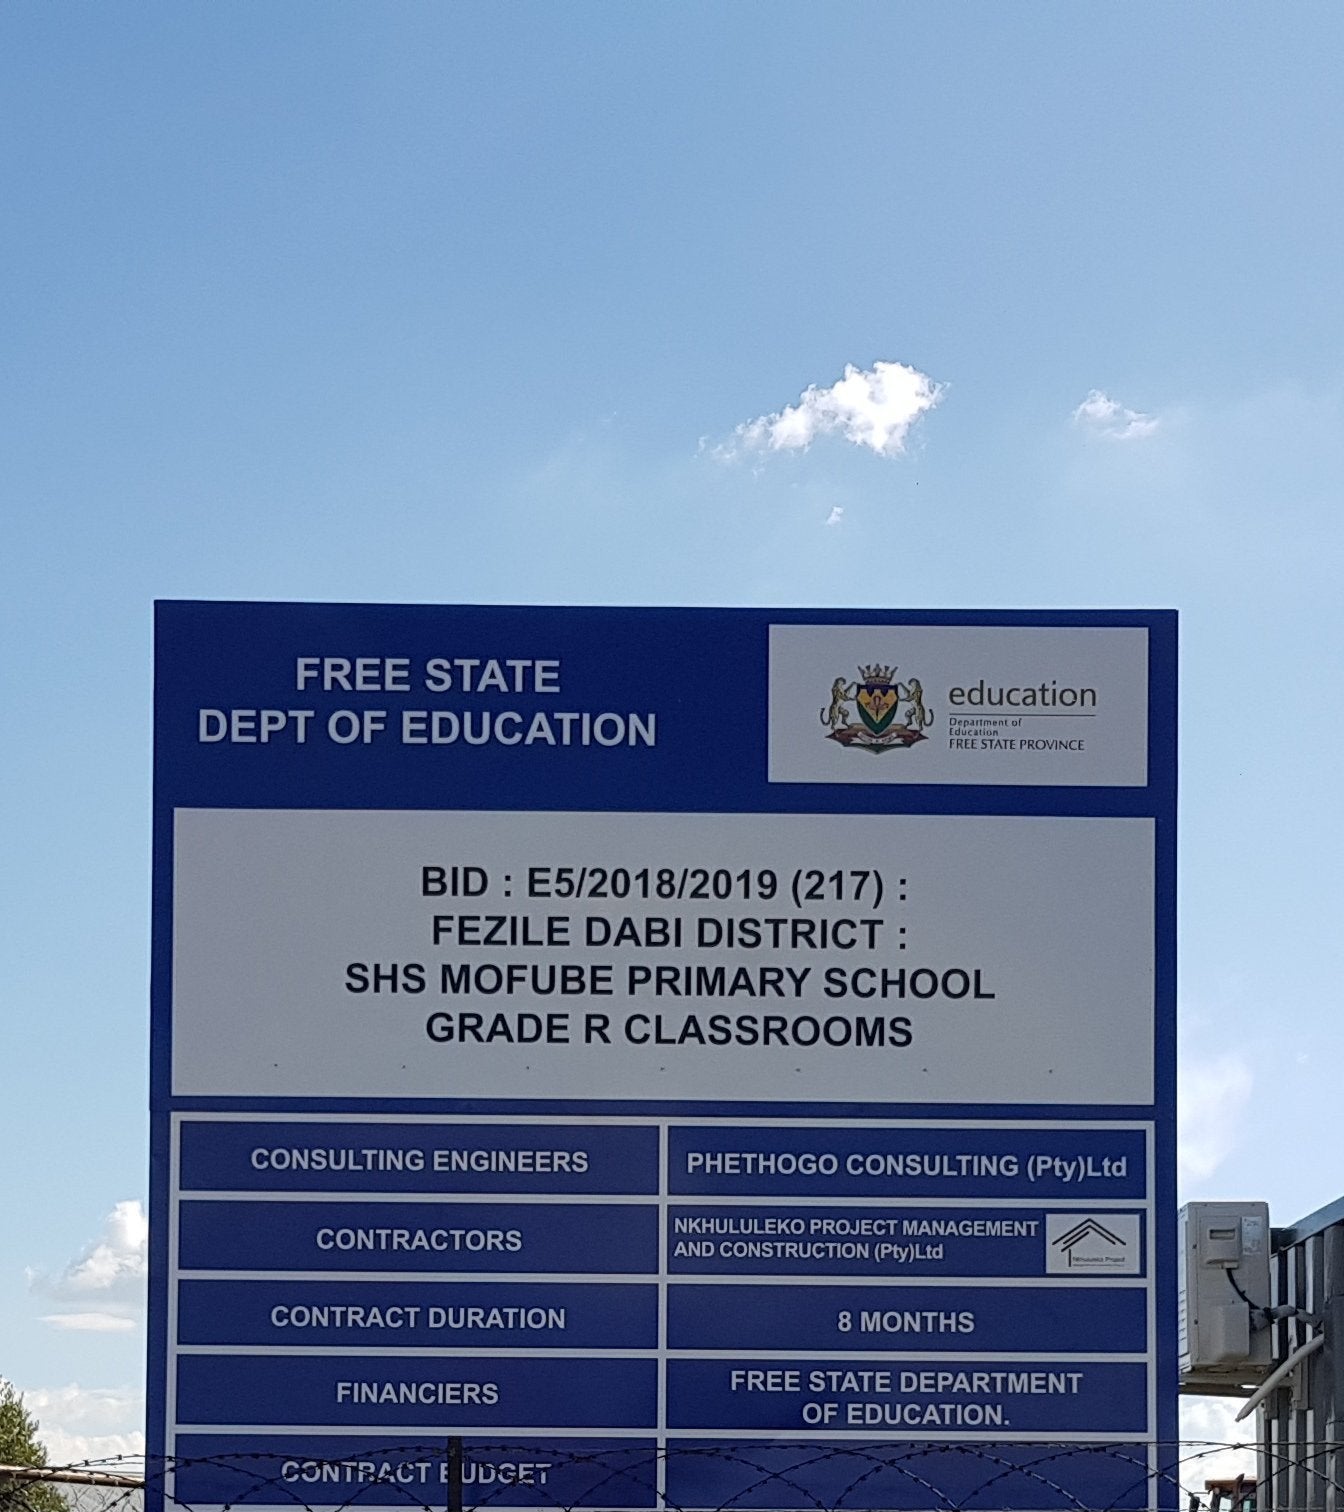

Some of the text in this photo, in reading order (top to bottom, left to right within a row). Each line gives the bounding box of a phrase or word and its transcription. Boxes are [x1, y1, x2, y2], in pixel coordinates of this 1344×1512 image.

[297, 658, 560, 692] FREE STATE
[949, 680, 1096, 706] education
[200, 709, 655, 746] DEPT OF EDUCATION
[950, 718, 1022, 728] Department of
[950, 727, 998, 736] Education
[950, 739, 1084, 750] FREE STATE PROVINCE
[423, 867, 906, 909] BID : E5/2018/2019 (217) :
[434, 916, 905, 949] FEZILE DABI DISTRICT :
[346, 963, 995, 999] SHS MOFUBE PRIMARY SCHOOL
[427, 1013, 912, 1047] GRADE R CLASSROOMS
[252, 1149, 588, 1172] CONSULTING ENGINEERS
[688, 1153, 1126, 1182] PHETHOGO CONSULTING (Pty)Ltd
[675, 1218, 1039, 1236] NKHULULEKO PROJECT MANAGEMENT
[317, 1229, 521, 1251] CONTRACTORS
[674, 1242, 943, 1262] AND CONSTRUCTION (Pty)Ltd
[272, 1306, 564, 1328] CONTRACT DURATION
[838, 1311, 974, 1332] 8 MONTHS
[732, 1371, 1083, 1393] FREE STATE DEPARTMENT
[338, 1383, 498, 1404] FINANCIERS
[803, 1403, 1009, 1425] OF EDUCATION.
[282, 1460, 431, 1483] CONTRACT
